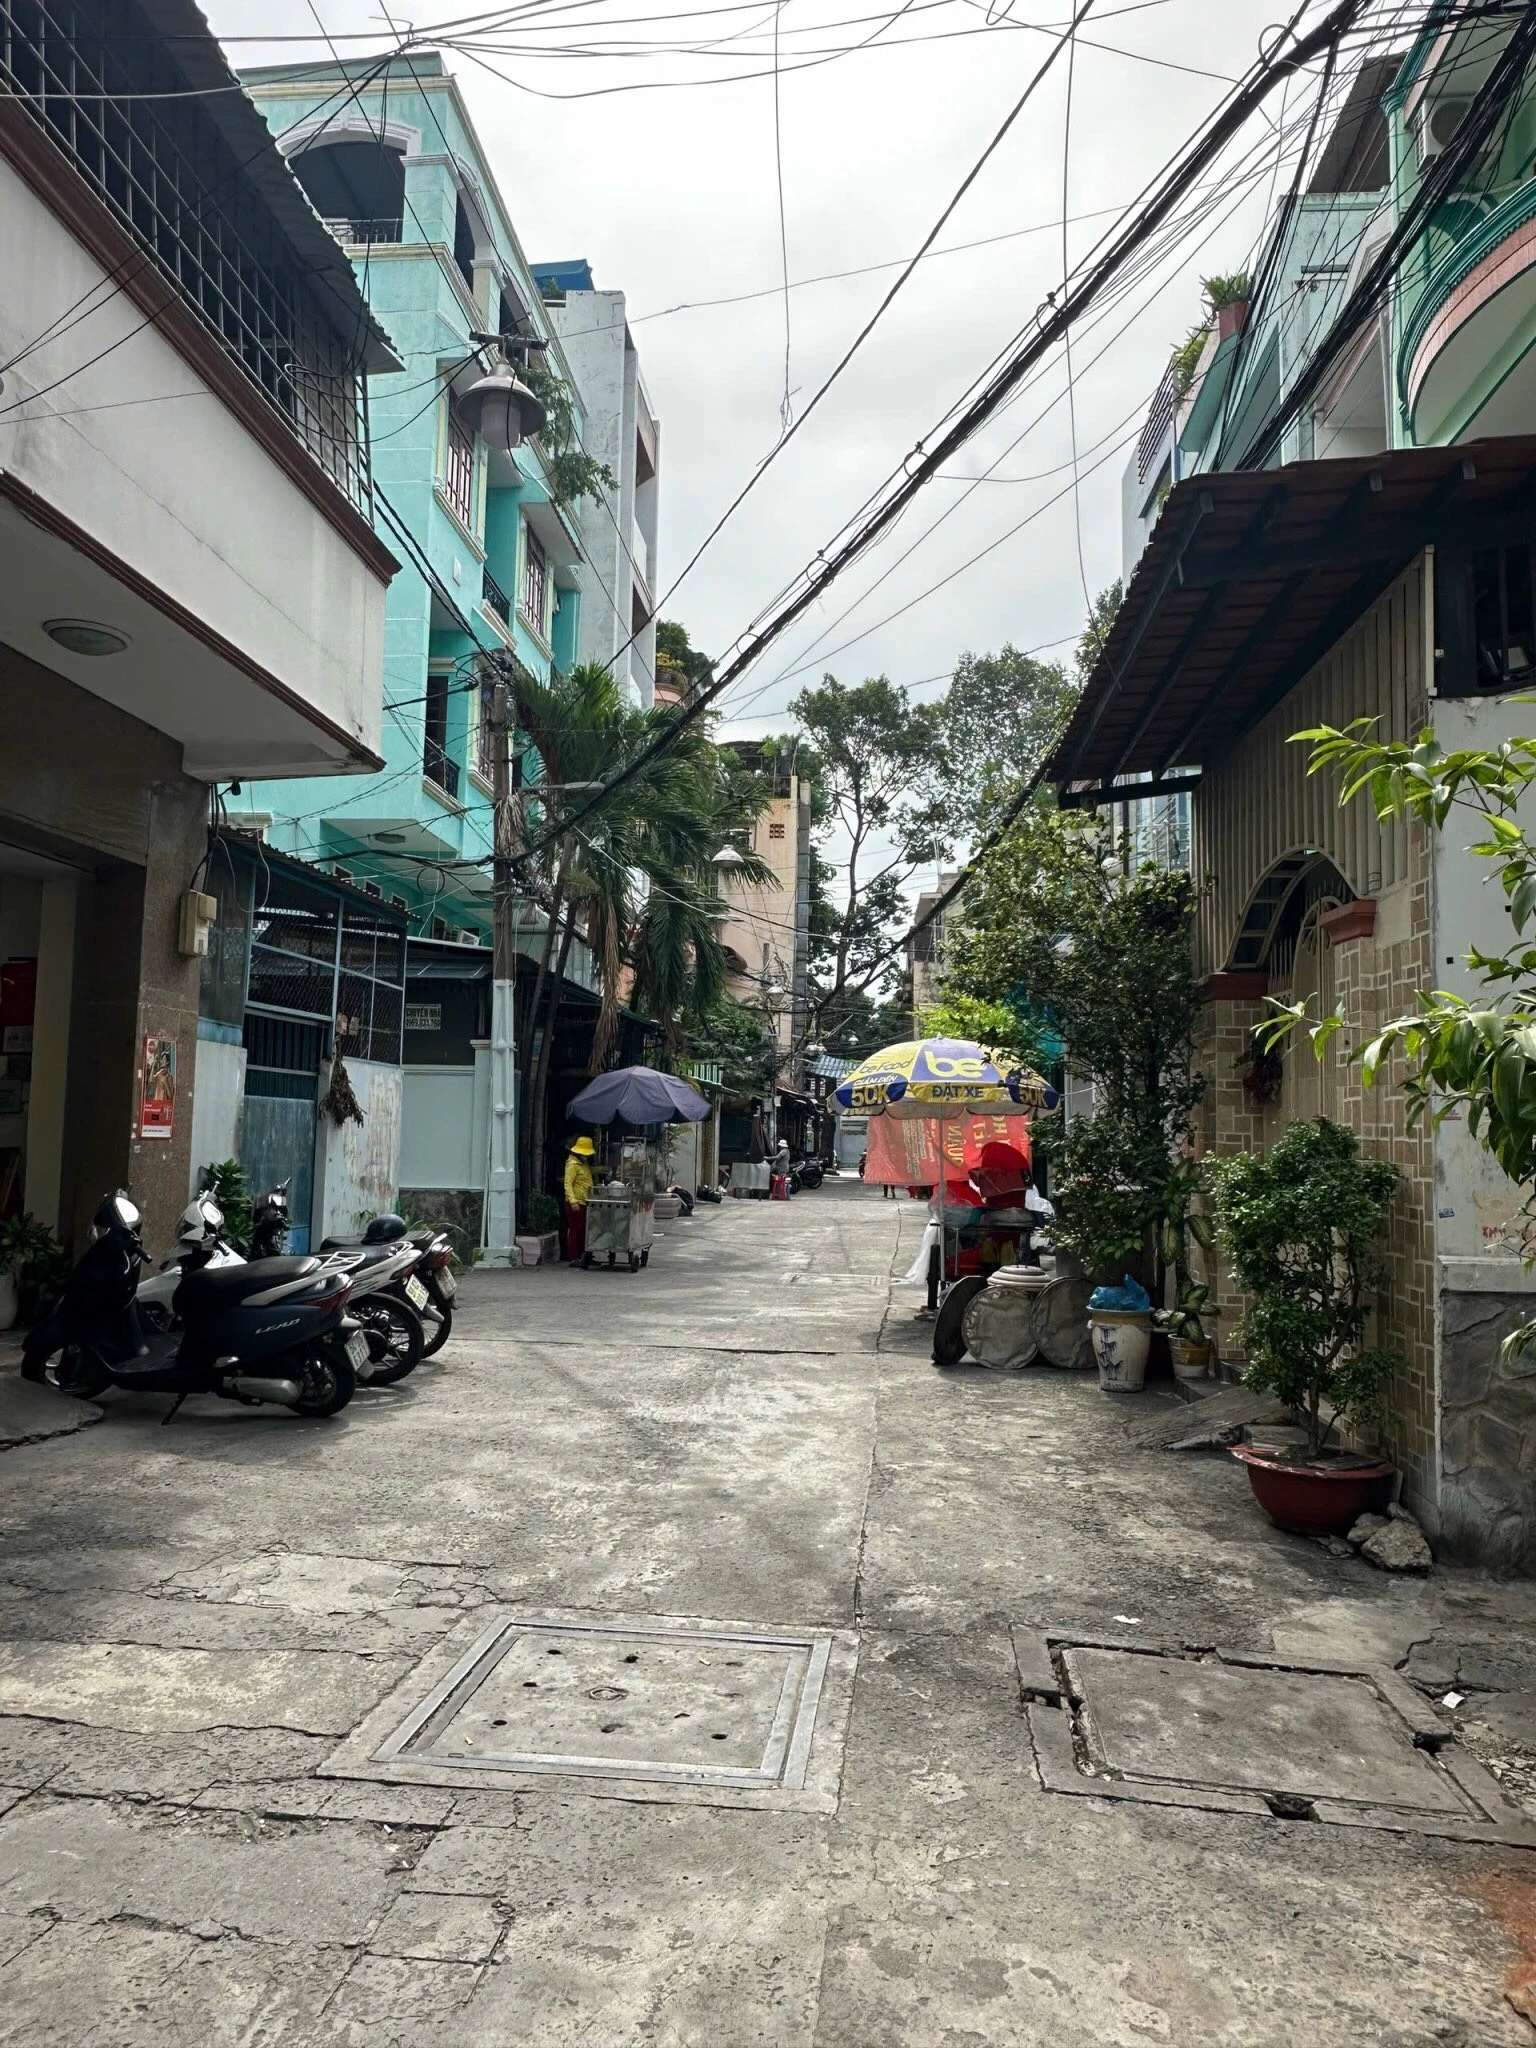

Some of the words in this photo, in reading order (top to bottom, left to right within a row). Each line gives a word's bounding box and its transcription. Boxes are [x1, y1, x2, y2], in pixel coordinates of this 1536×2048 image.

[924, 1051, 987, 1078] be
[851, 1084, 891, 1107] 50K
[932, 1082, 961, 1101] ĐẶT
[964, 1085, 984, 1098] XE
[1019, 1087, 1048, 1108] 50K
